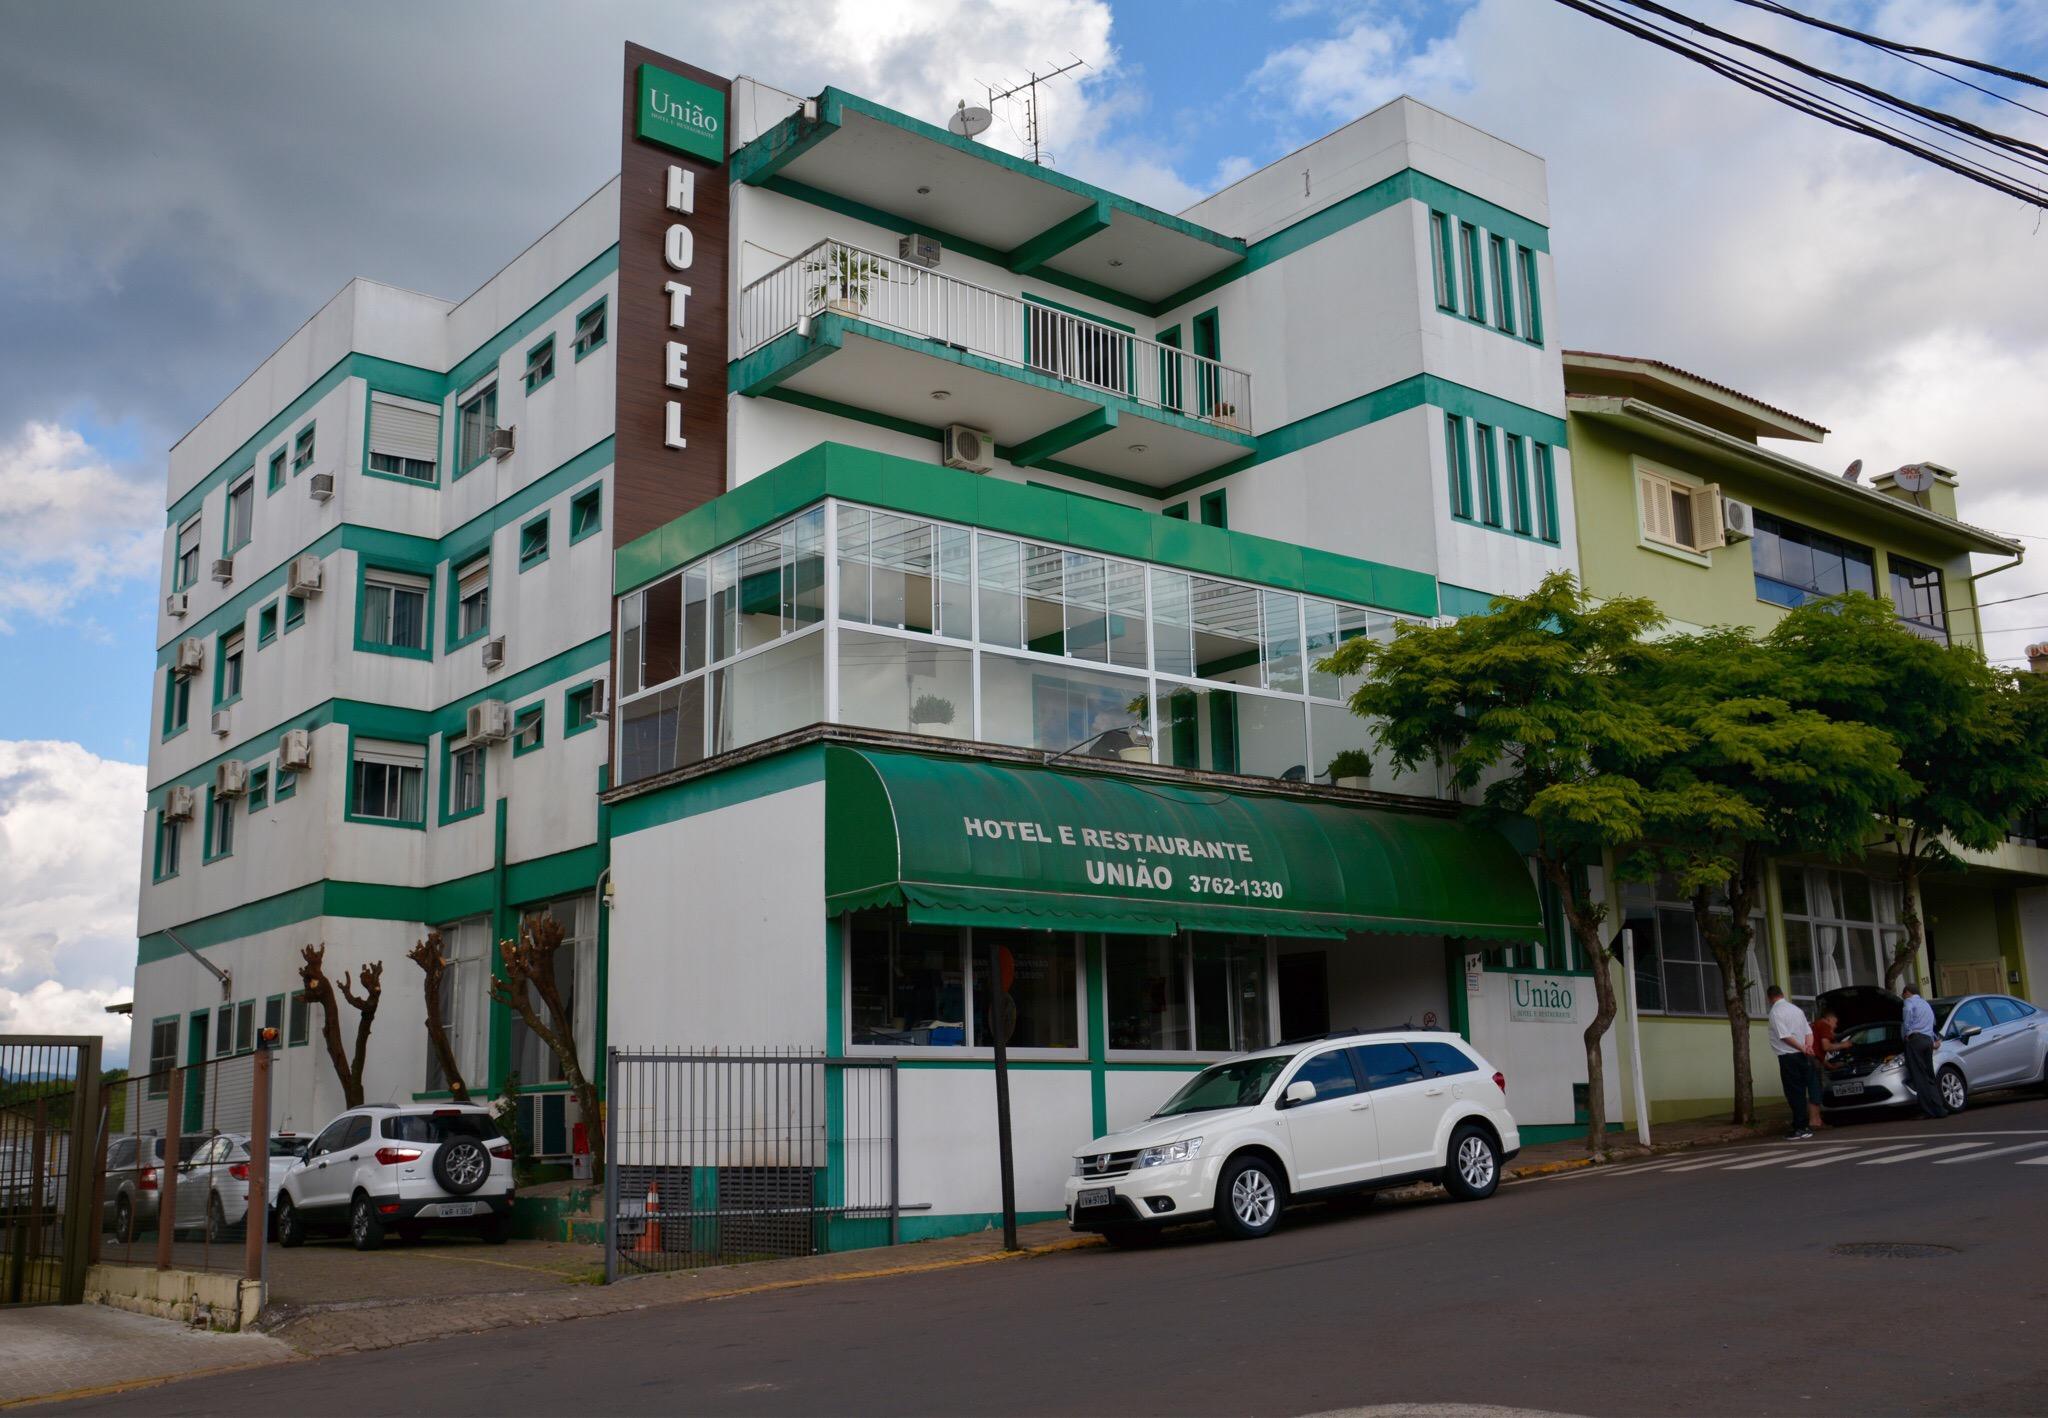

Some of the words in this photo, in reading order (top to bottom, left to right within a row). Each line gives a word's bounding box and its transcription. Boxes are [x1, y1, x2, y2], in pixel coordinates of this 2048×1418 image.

[650, 88, 718, 132] União
[664, 164, 695, 450] HOTEL
[963, 816, 1052, 844] HOTEL
[1058, 825, 1077, 846] E
[1081, 827, 1253, 863] RESTAURANTE
[1085, 858, 1173, 890] UNIÃO
[1188, 874, 1284, 899] 3762-1330
[1514, 979, 1571, 1009] União
